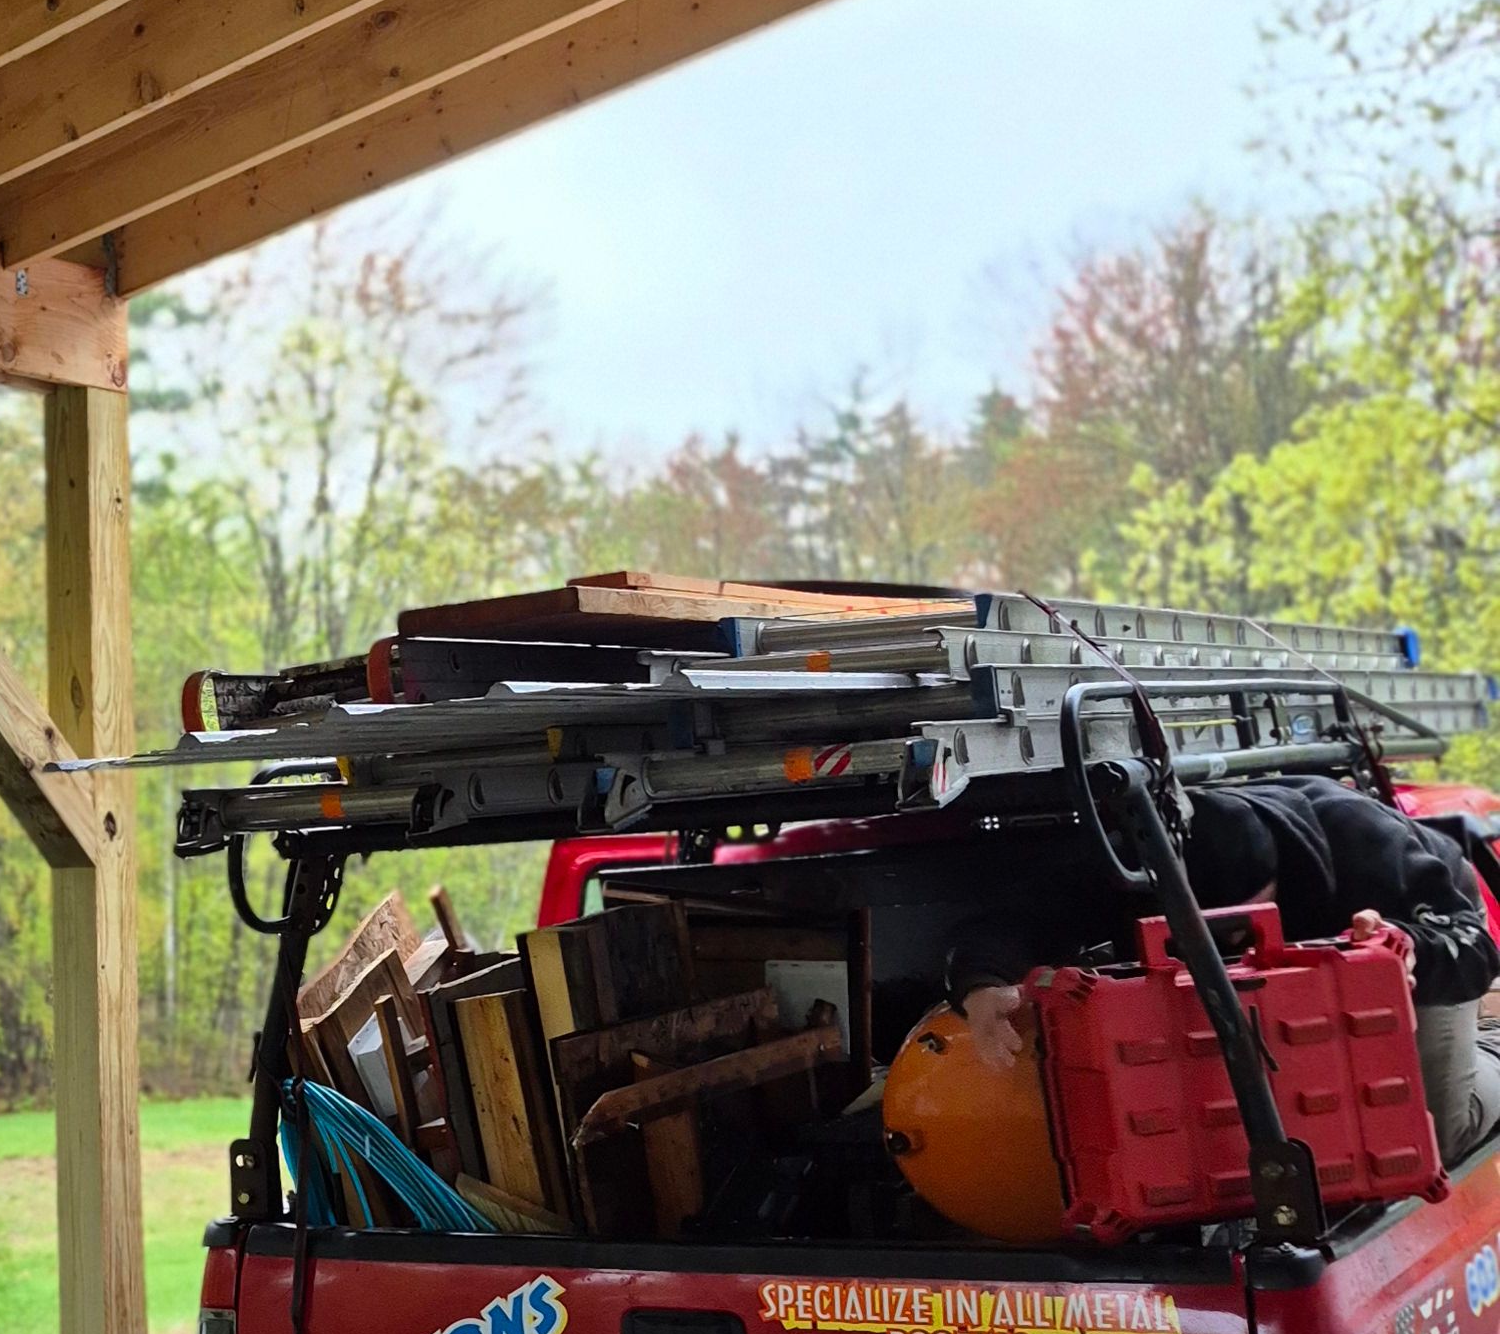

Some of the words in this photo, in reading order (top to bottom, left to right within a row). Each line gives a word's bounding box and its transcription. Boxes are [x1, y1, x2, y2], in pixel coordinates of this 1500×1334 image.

[759, 1282, 932, 1324] SPECIALIZE
[943, 1287, 981, 1326] IN
[993, 1289, 1051, 1328] ALL
[1064, 1292, 1172, 1332] METAL
